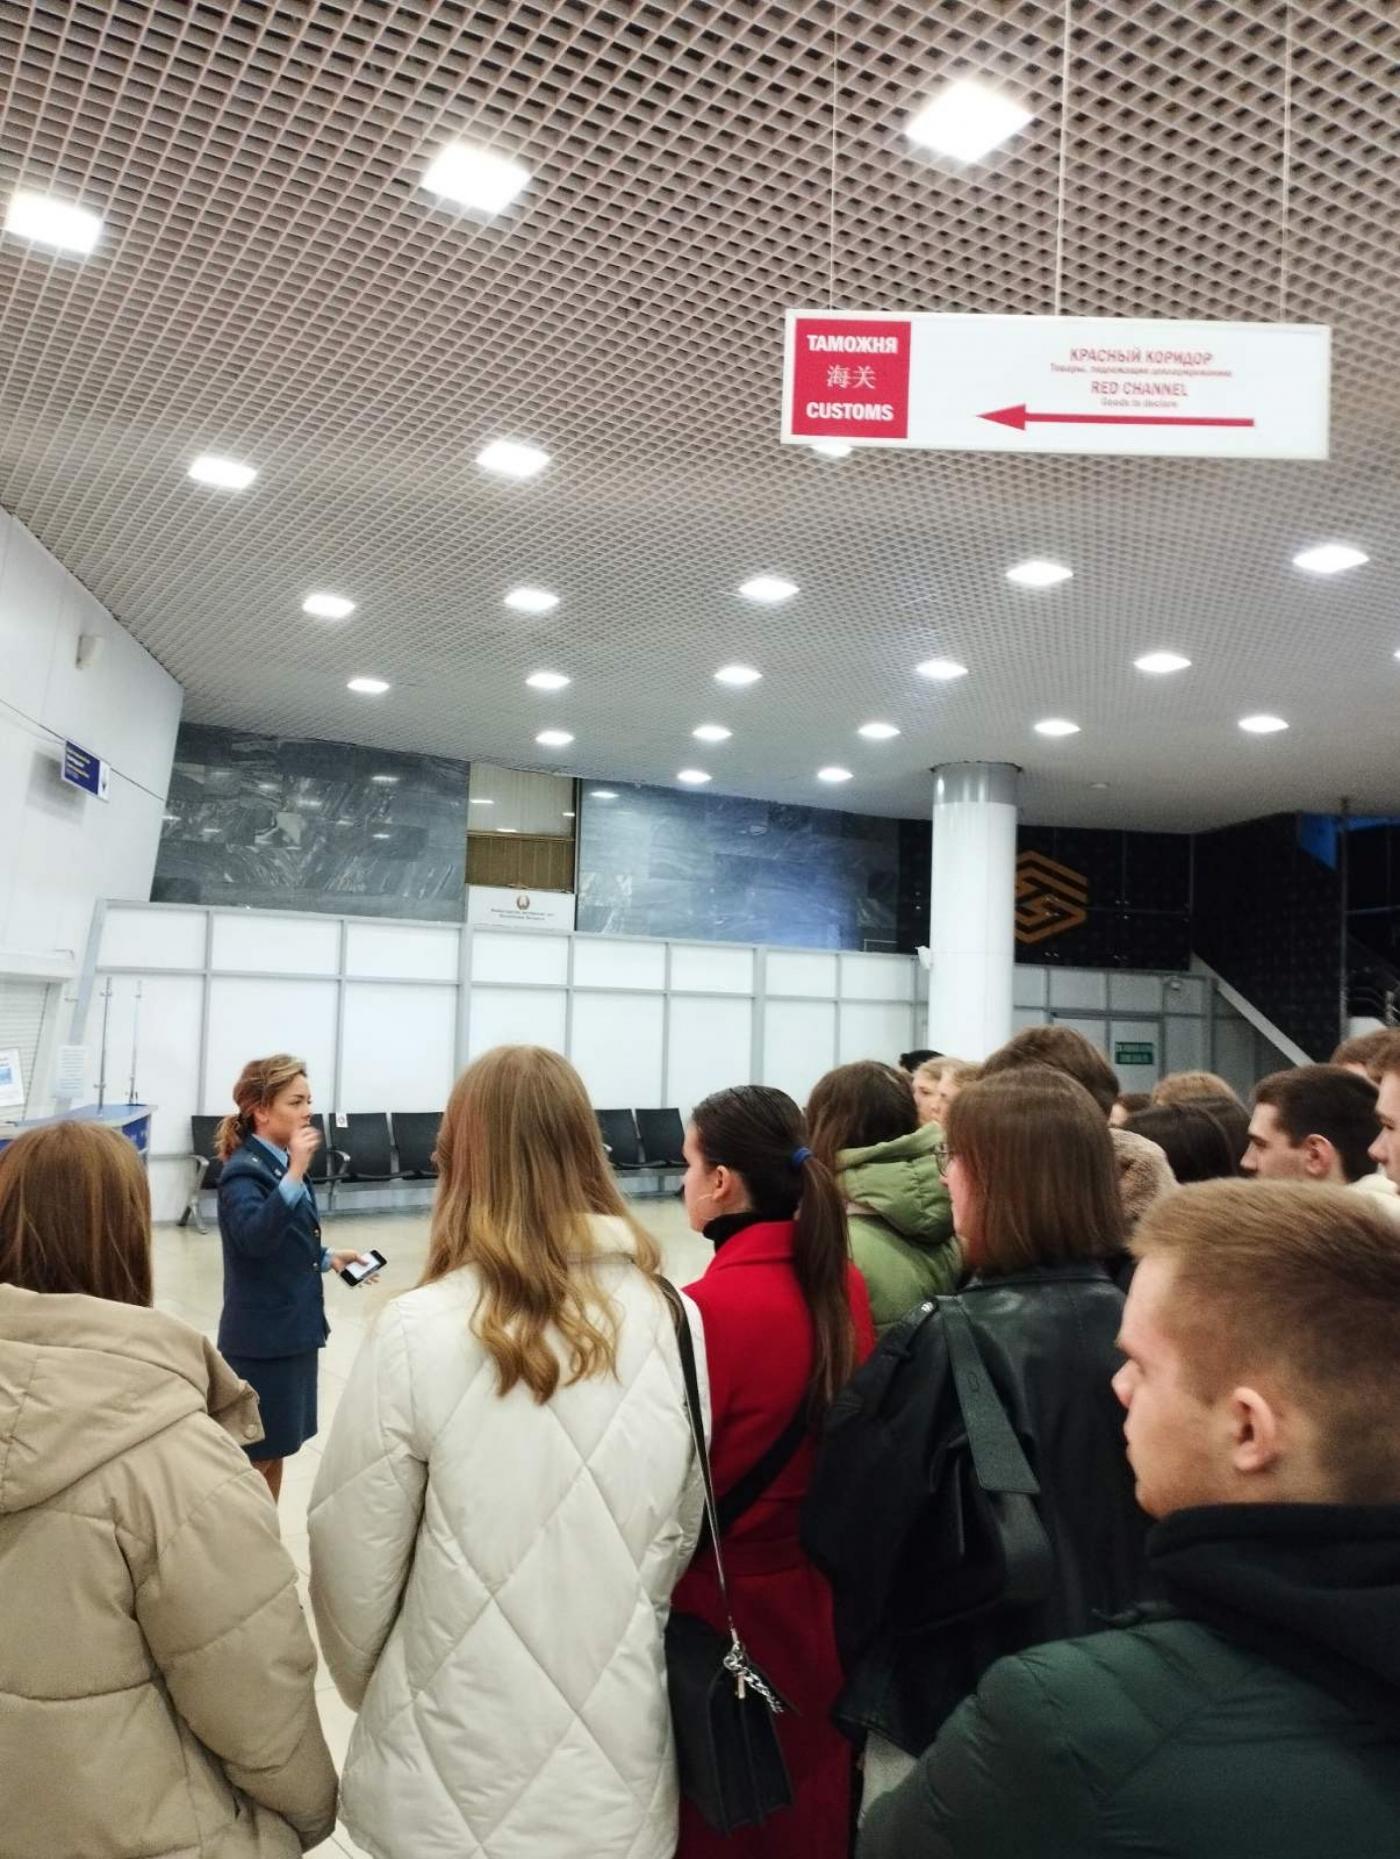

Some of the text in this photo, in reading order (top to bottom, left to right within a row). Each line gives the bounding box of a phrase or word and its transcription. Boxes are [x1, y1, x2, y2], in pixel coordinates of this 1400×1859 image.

[806, 335, 899, 355] ТАМОЖНЯ
[1070, 347, 1213, 366] КРАСНЫЙ КОРИДОР
[826, 364, 877, 389] 海关
[1091, 381, 1189, 397] RED CHANNEL
[806, 402, 894, 422] CUSTOMS
